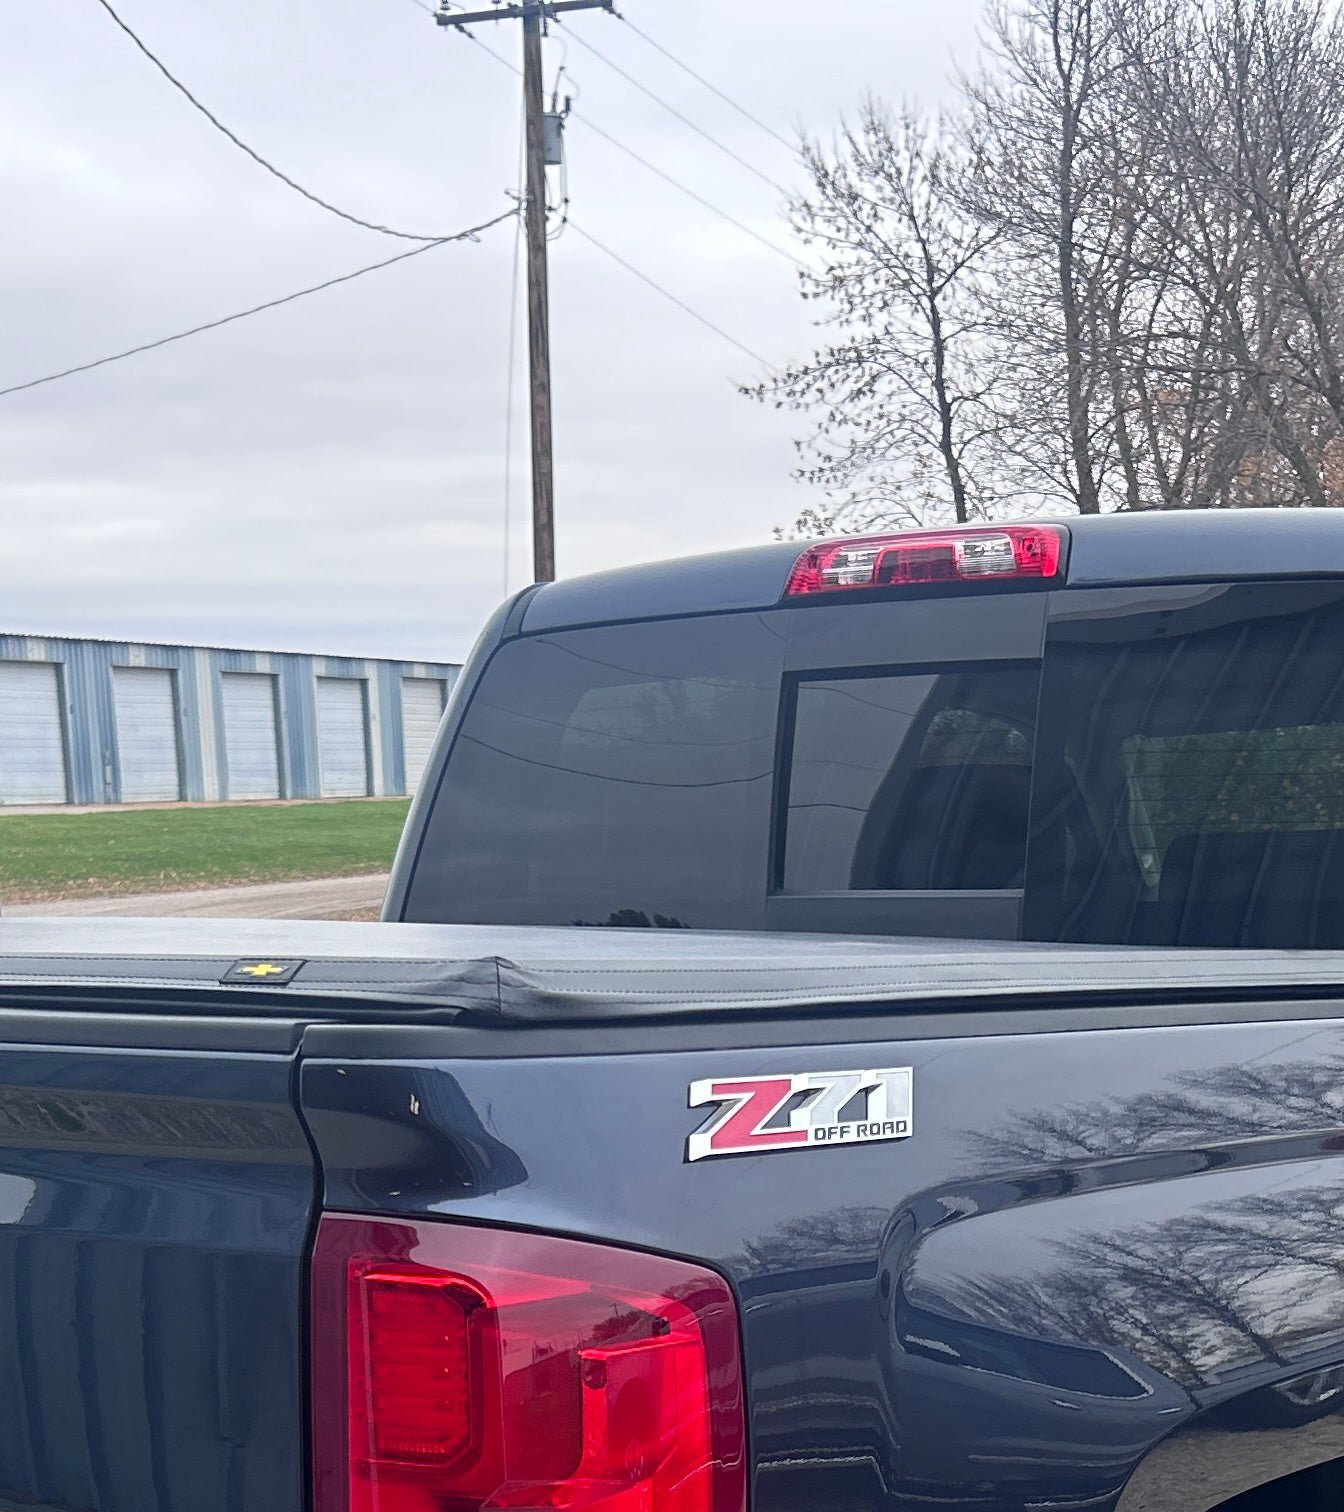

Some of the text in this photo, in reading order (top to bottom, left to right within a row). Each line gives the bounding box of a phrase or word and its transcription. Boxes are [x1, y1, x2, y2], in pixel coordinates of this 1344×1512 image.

[688, 1067, 913, 1161] Z71
[813, 1119, 907, 1141] OFF ROAD
